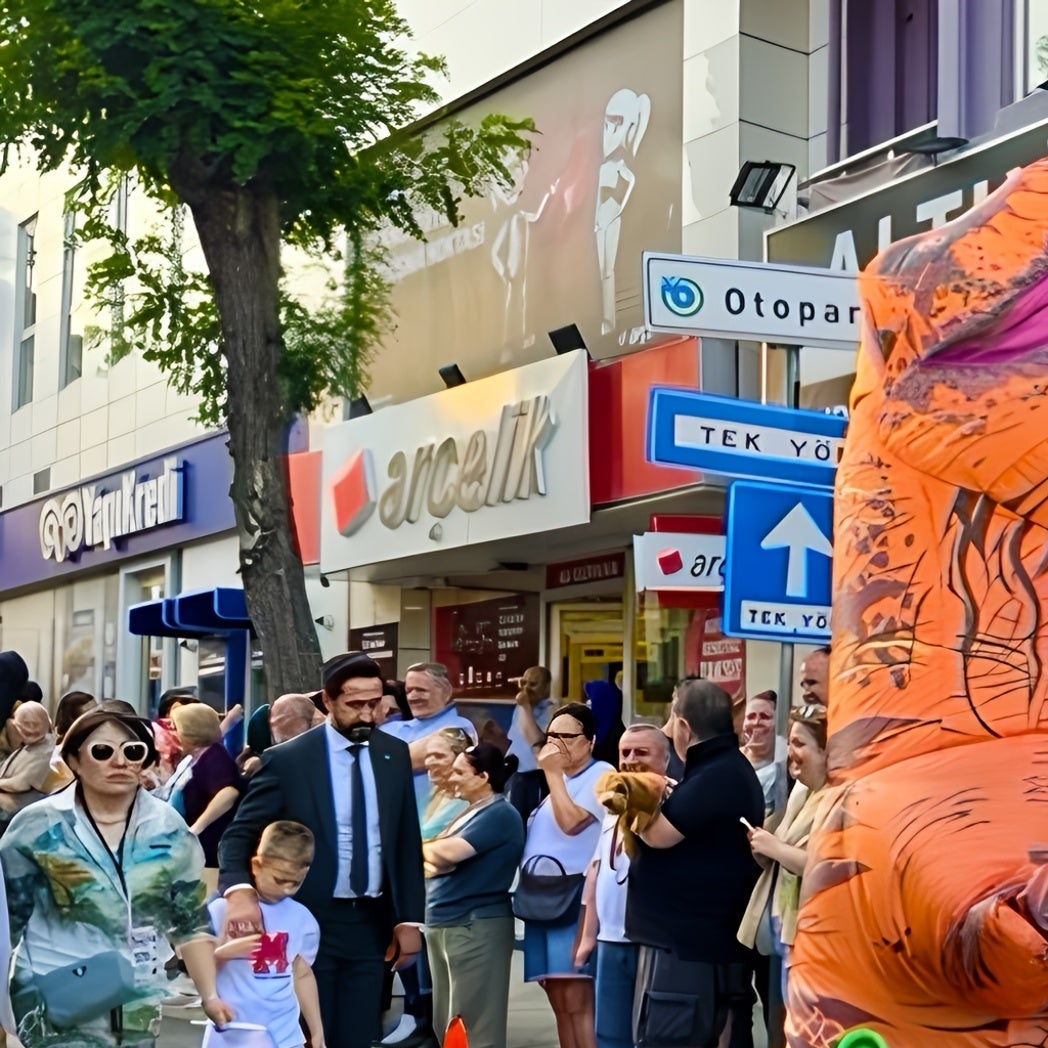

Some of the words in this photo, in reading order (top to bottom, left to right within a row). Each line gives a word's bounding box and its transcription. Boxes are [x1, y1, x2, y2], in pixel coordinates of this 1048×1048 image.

[725, 288, 860, 327] Otopar
[701, 425, 762, 453] TEK
[790, 438, 831, 461] YÖ
[802, 612, 828, 630] YÖ
